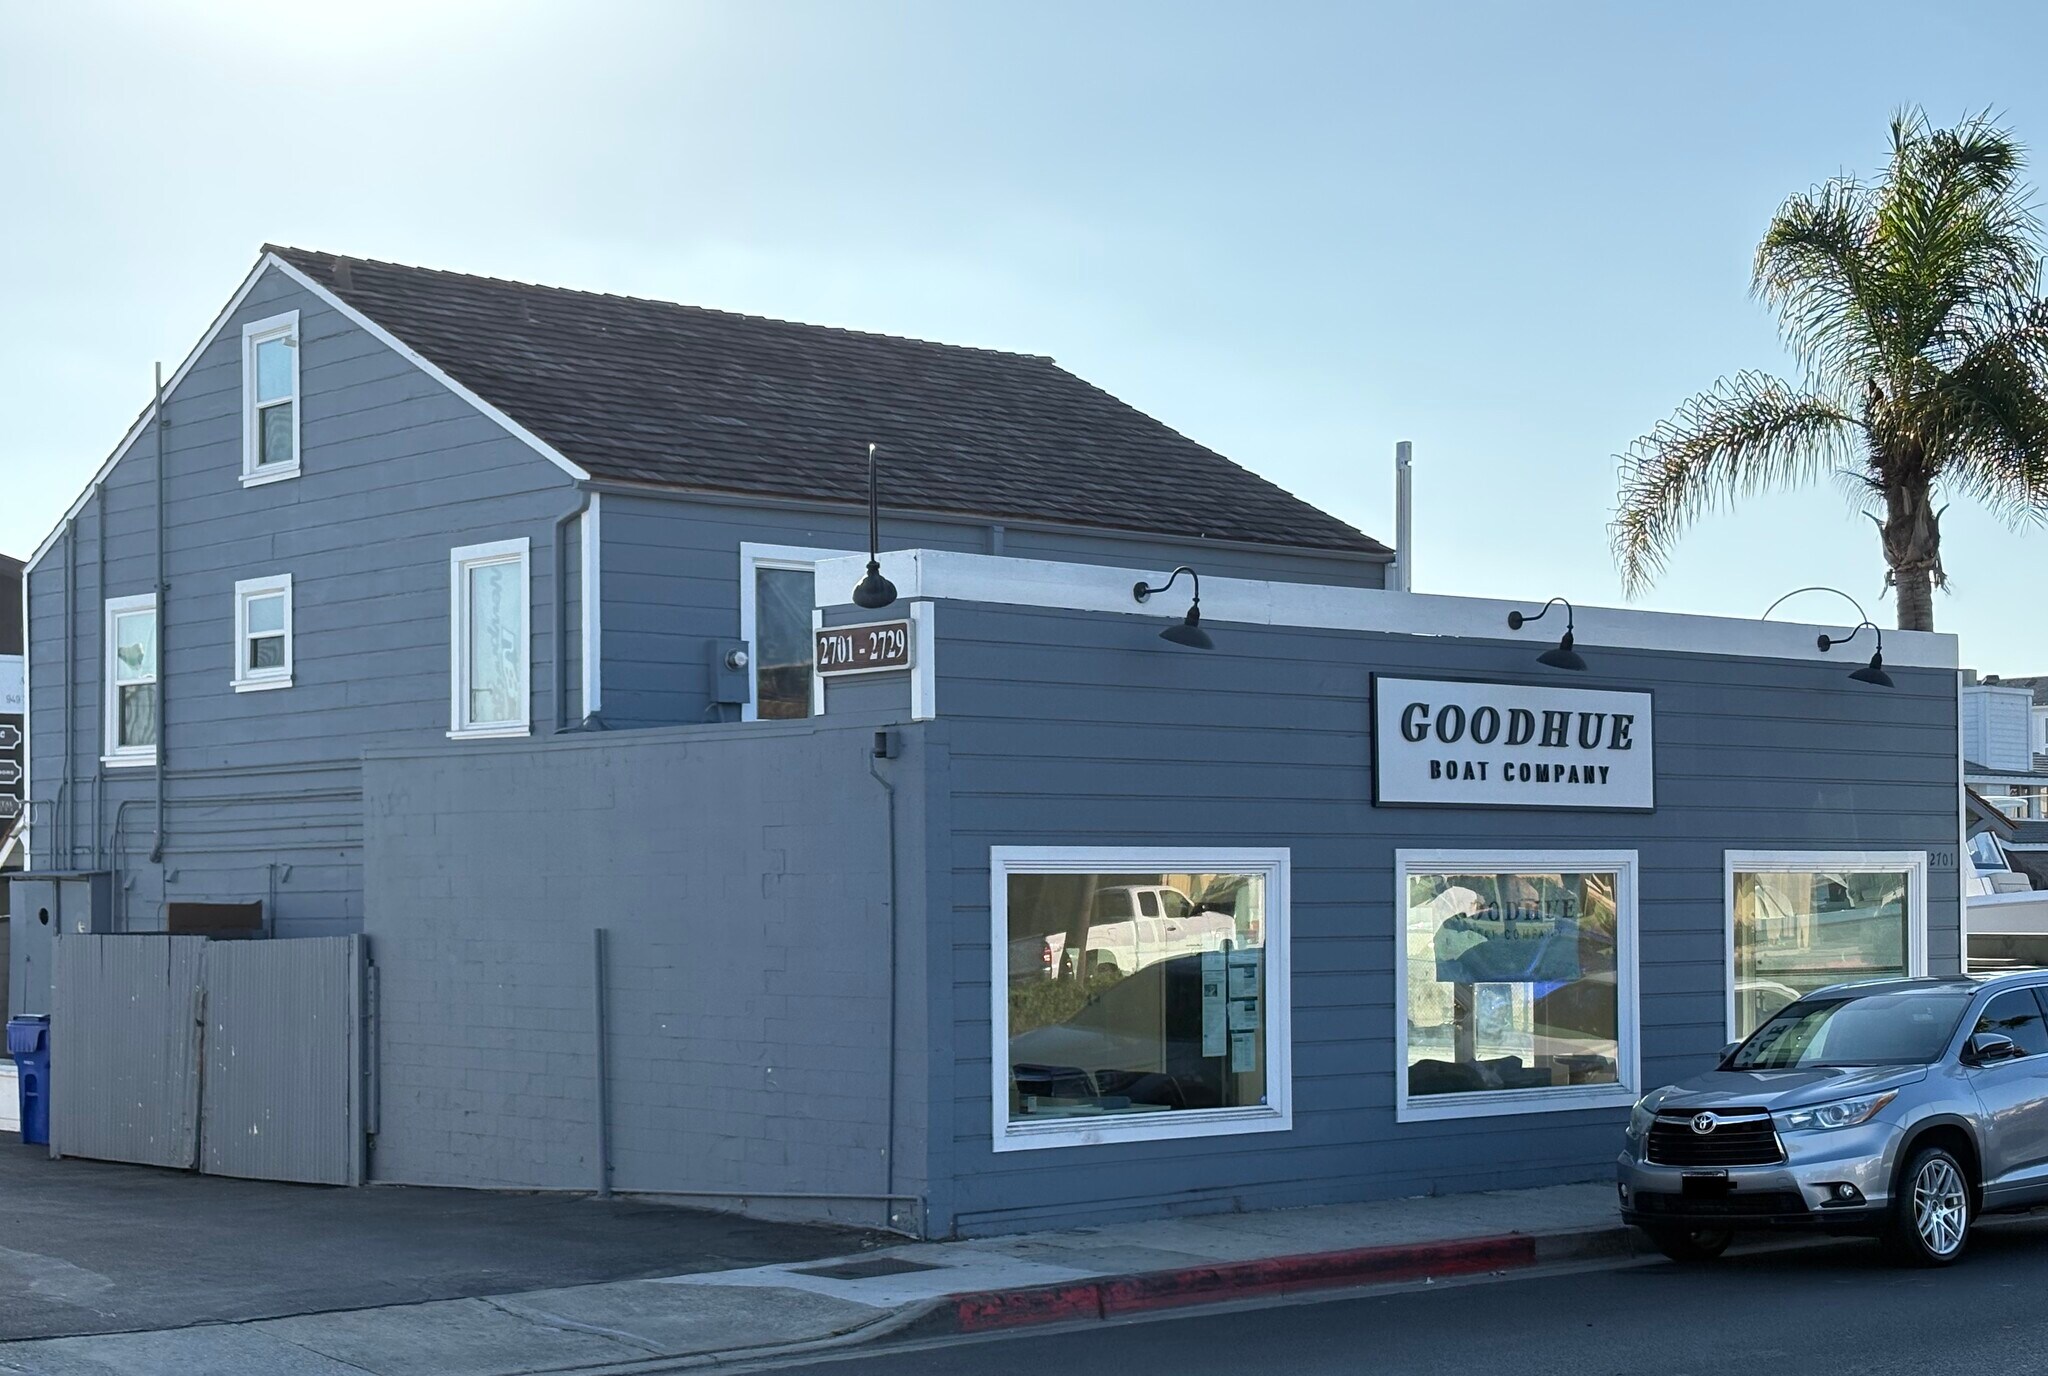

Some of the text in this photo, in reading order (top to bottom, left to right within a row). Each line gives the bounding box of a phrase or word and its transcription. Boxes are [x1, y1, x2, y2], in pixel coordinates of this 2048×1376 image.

[820, 635, 854, 665] 2701
[869, 629, 905, 660] 2729
[1400, 702, 1635, 751] GOODHUE
[1430, 759, 1610, 785] BOAT COMPANY
[1929, 852, 1954, 867] 2701
